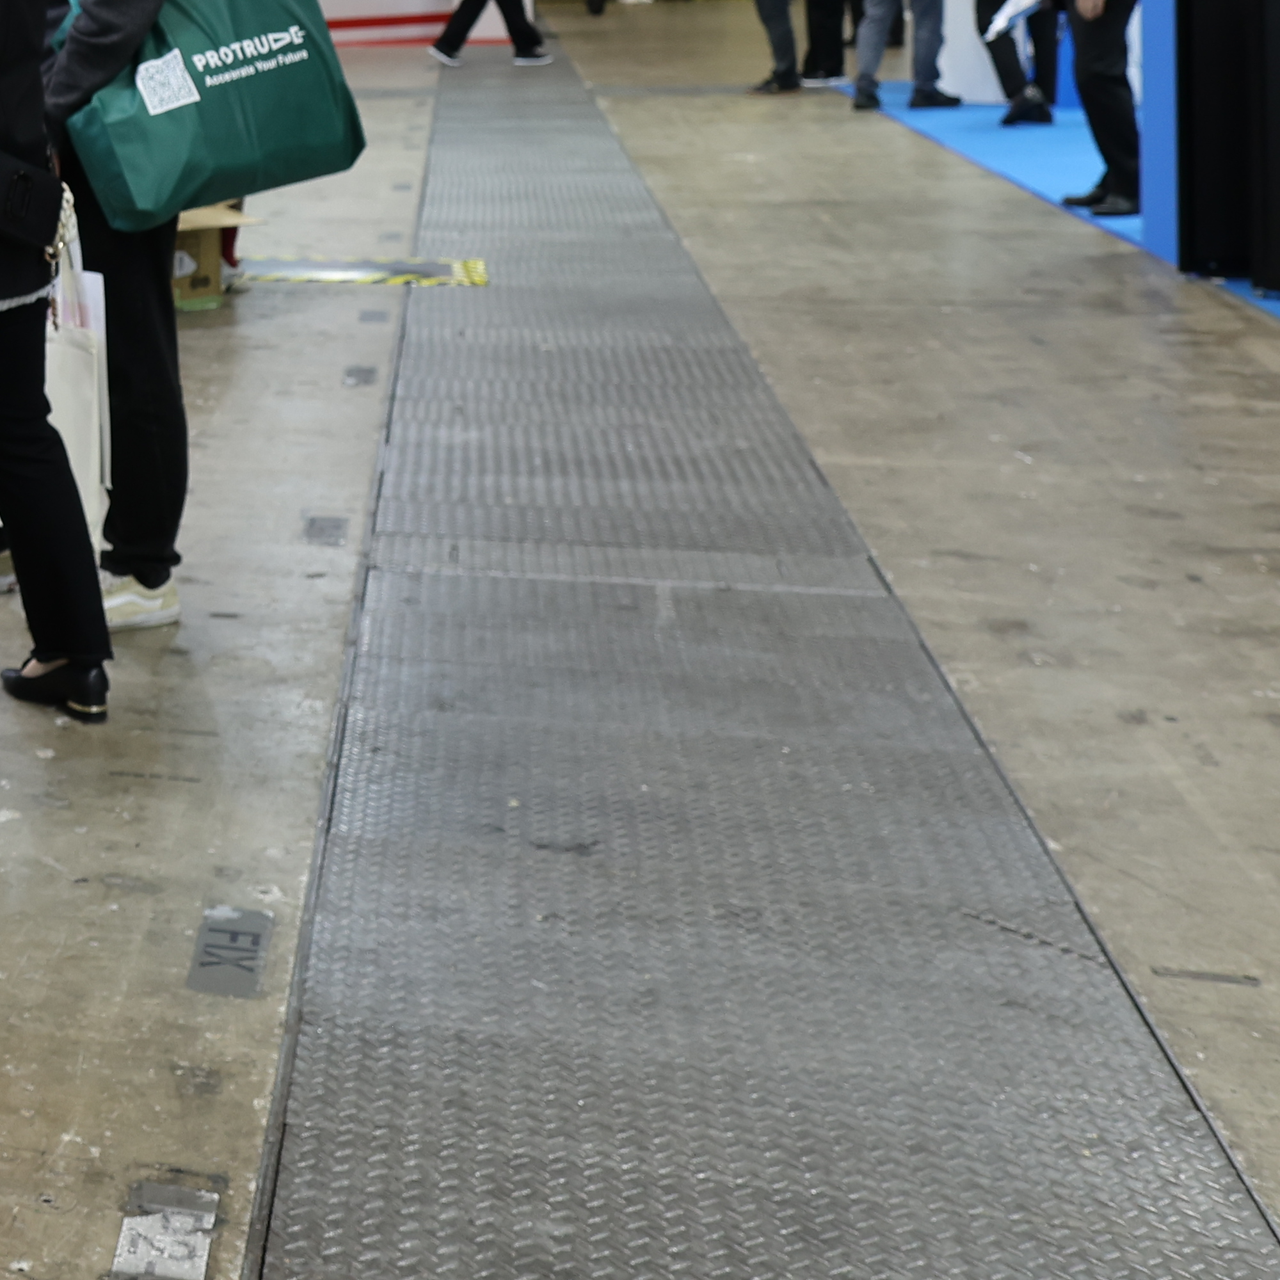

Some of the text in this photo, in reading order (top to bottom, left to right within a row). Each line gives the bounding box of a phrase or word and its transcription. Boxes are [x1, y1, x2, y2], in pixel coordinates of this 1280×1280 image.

[192, 24, 306, 73] PROTRUDE
[253, 54, 278, 72] Your
[198, 926, 262, 973] FIX
